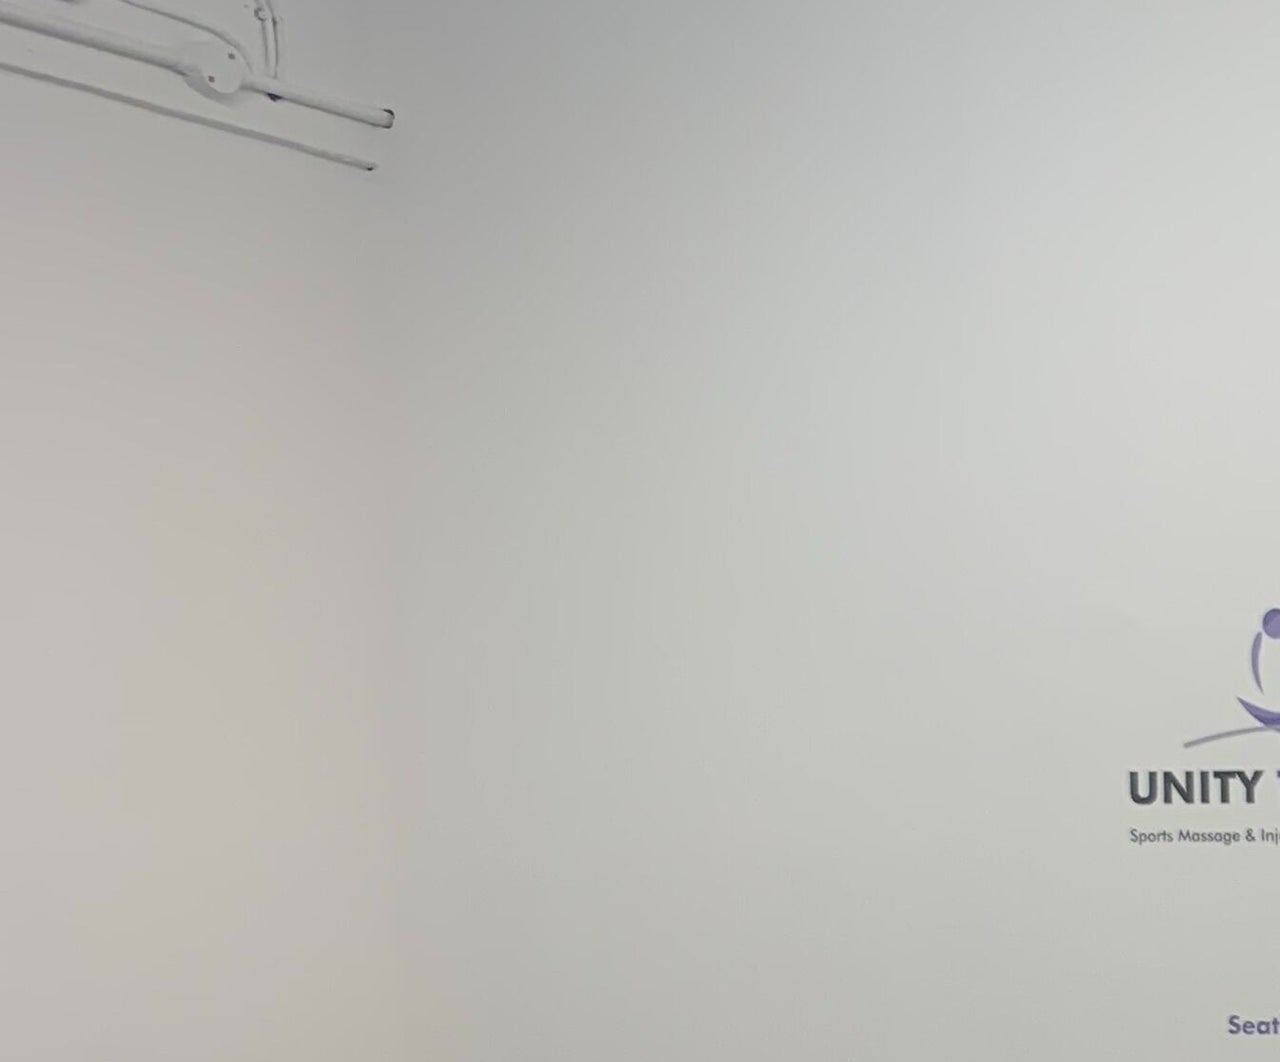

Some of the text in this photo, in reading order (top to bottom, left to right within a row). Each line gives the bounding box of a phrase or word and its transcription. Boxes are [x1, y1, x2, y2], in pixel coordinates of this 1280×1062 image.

[1128, 770, 1263, 805] UNITY
[1130, 827, 1174, 845] Sports
[1178, 828, 1241, 846] Massage
[1245, 828, 1256, 842] &
